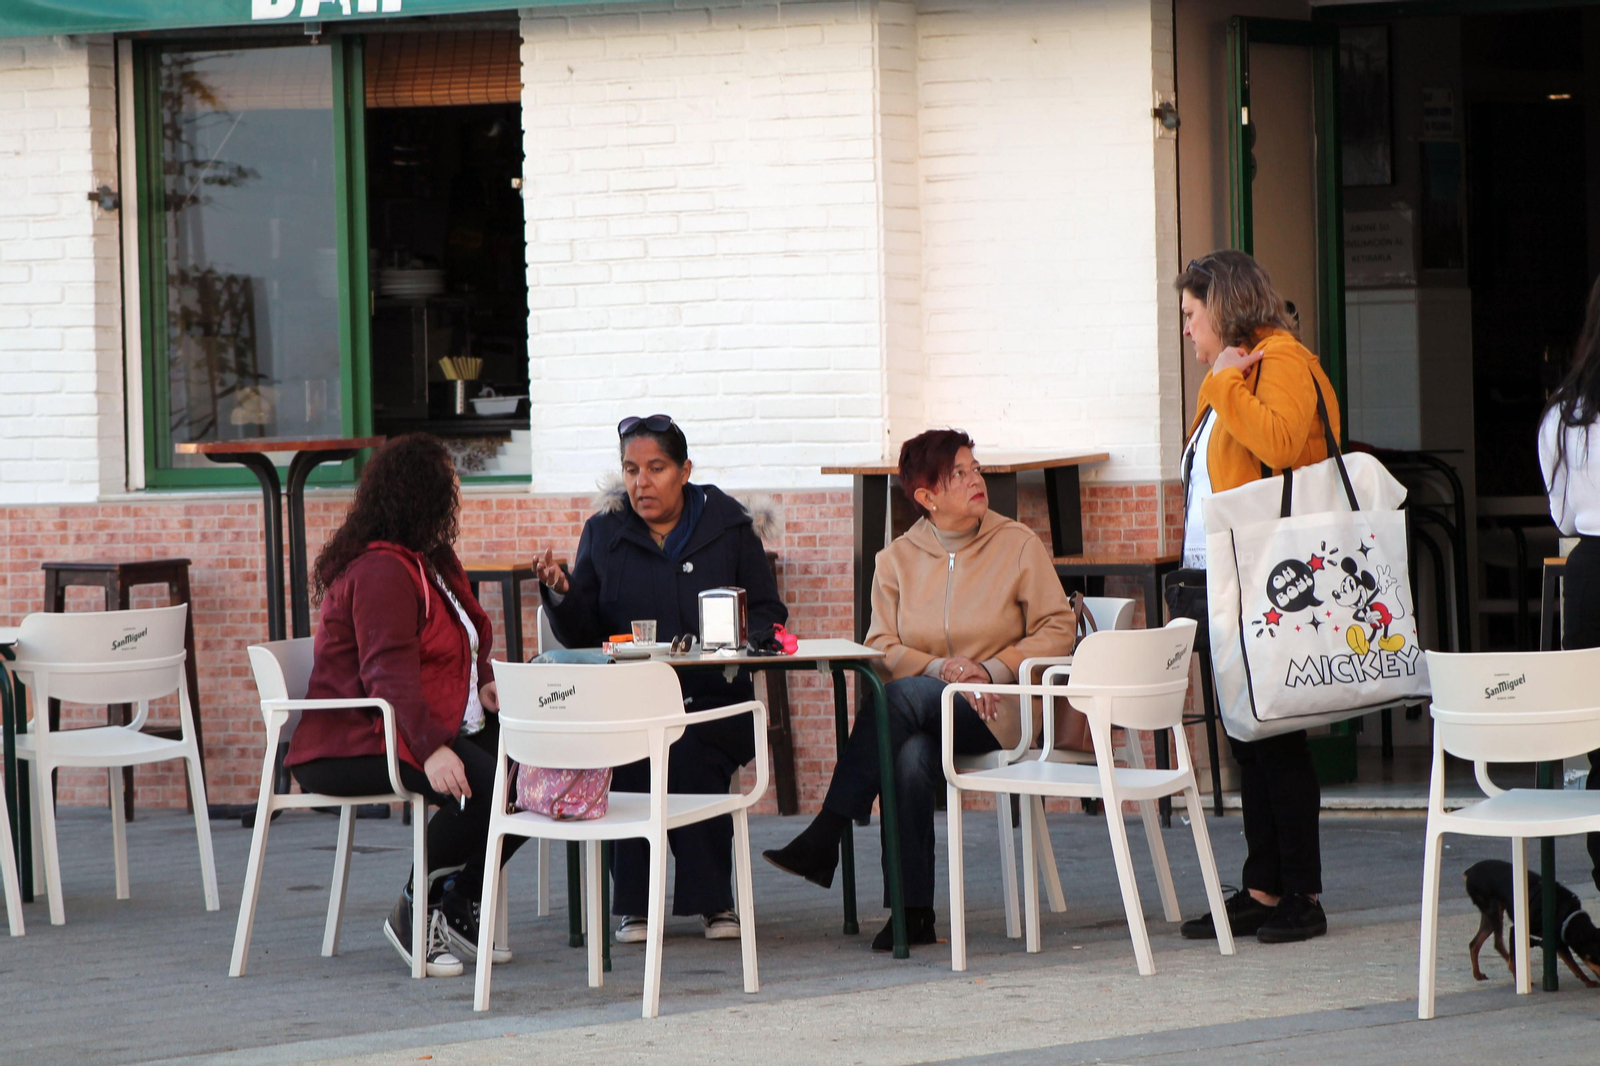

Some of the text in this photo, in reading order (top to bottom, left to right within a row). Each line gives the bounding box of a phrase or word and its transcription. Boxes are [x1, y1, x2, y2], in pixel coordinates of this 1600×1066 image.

[1273, 566, 1297, 590] OH
[1275, 574, 1313, 608] BOY!
[111, 627, 148, 650] SanMiguel
[1285, 645, 1420, 688] MICKEY
[538, 685, 576, 708] SanMiguel
[1485, 673, 1526, 699] SanMiguel
